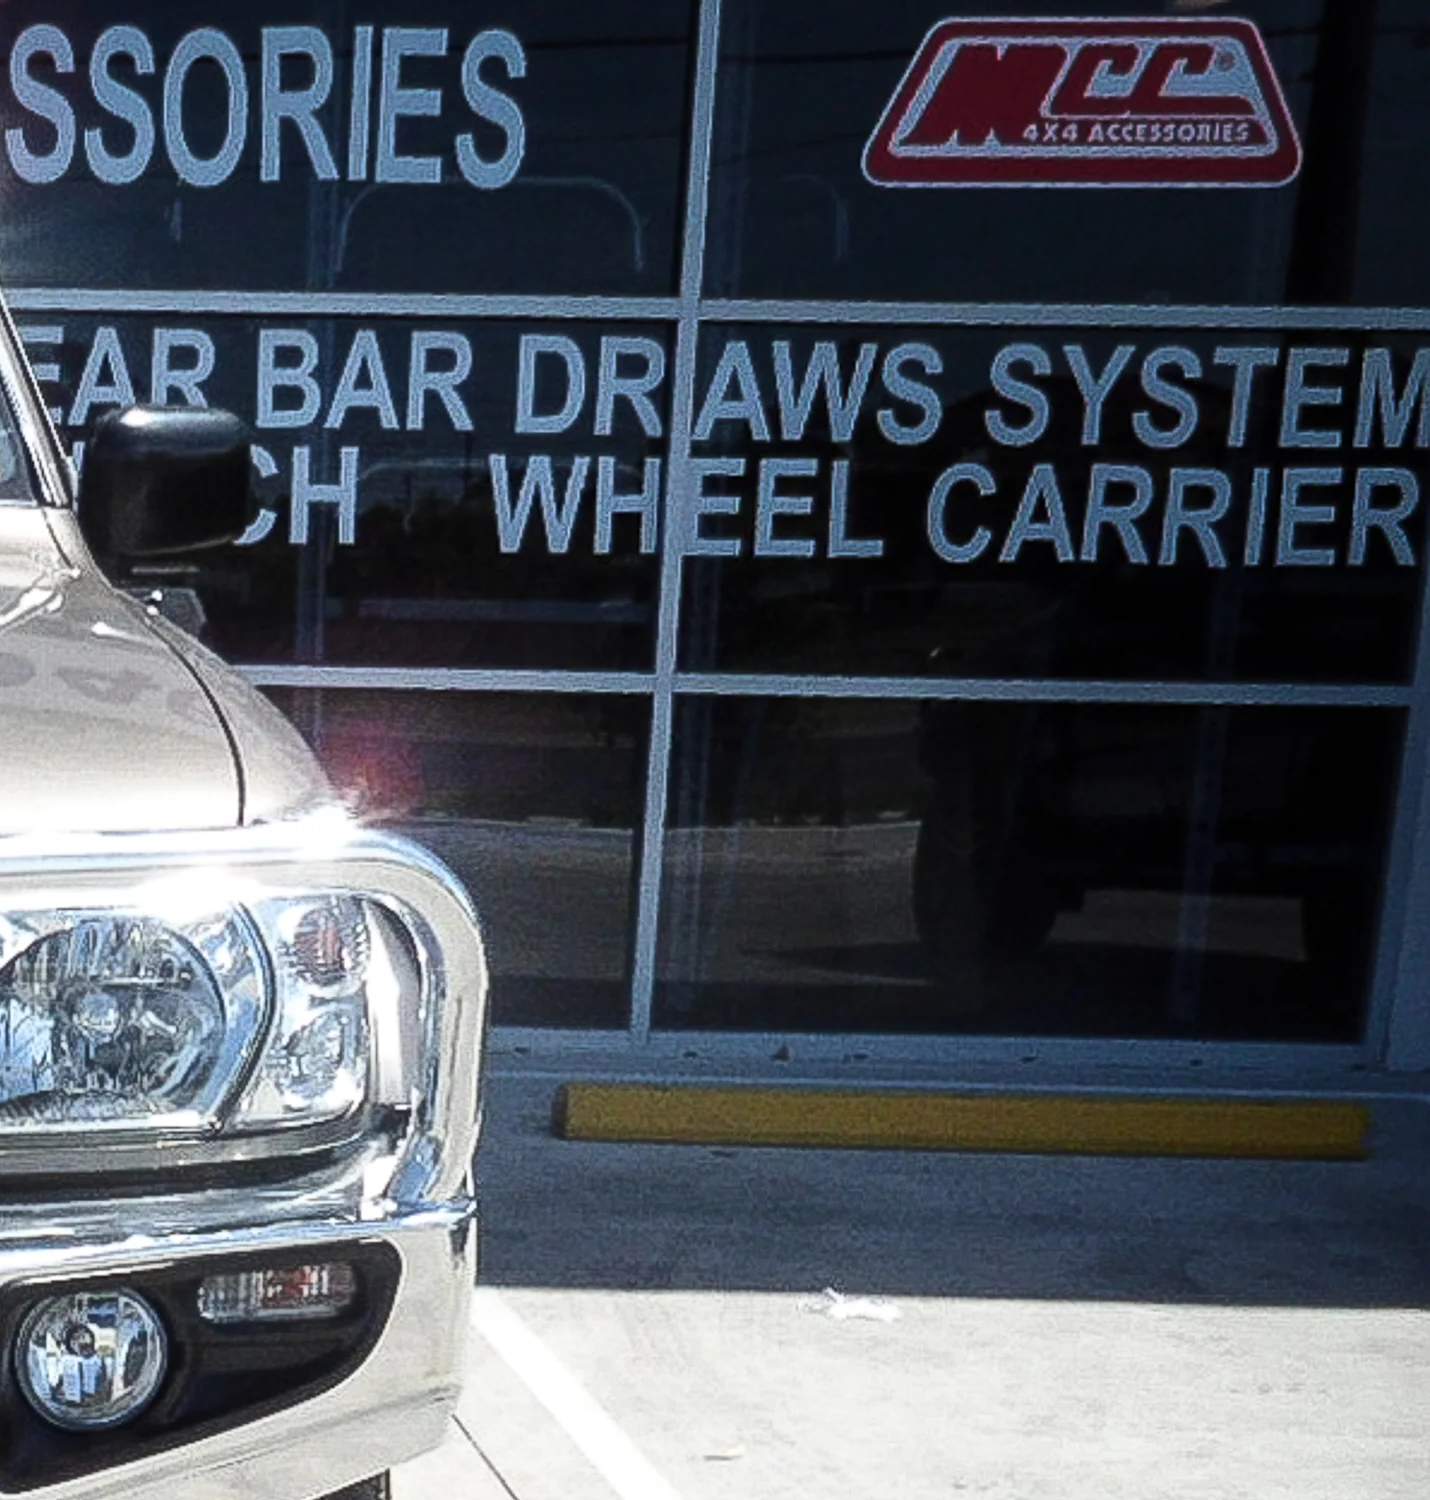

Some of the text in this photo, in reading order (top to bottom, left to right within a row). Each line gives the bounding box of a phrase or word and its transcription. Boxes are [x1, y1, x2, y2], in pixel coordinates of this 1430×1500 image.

[904, 42, 1258, 145] MCC
[1022, 122, 1252, 143] 4X4 ACCESSORIES
[255, 327, 476, 432] BAR
[514, 334, 943, 446] DRAWS
[984, 343, 1430, 448] SYSTEM
[490, 453, 1420, 568] WHEEL CARRIER
